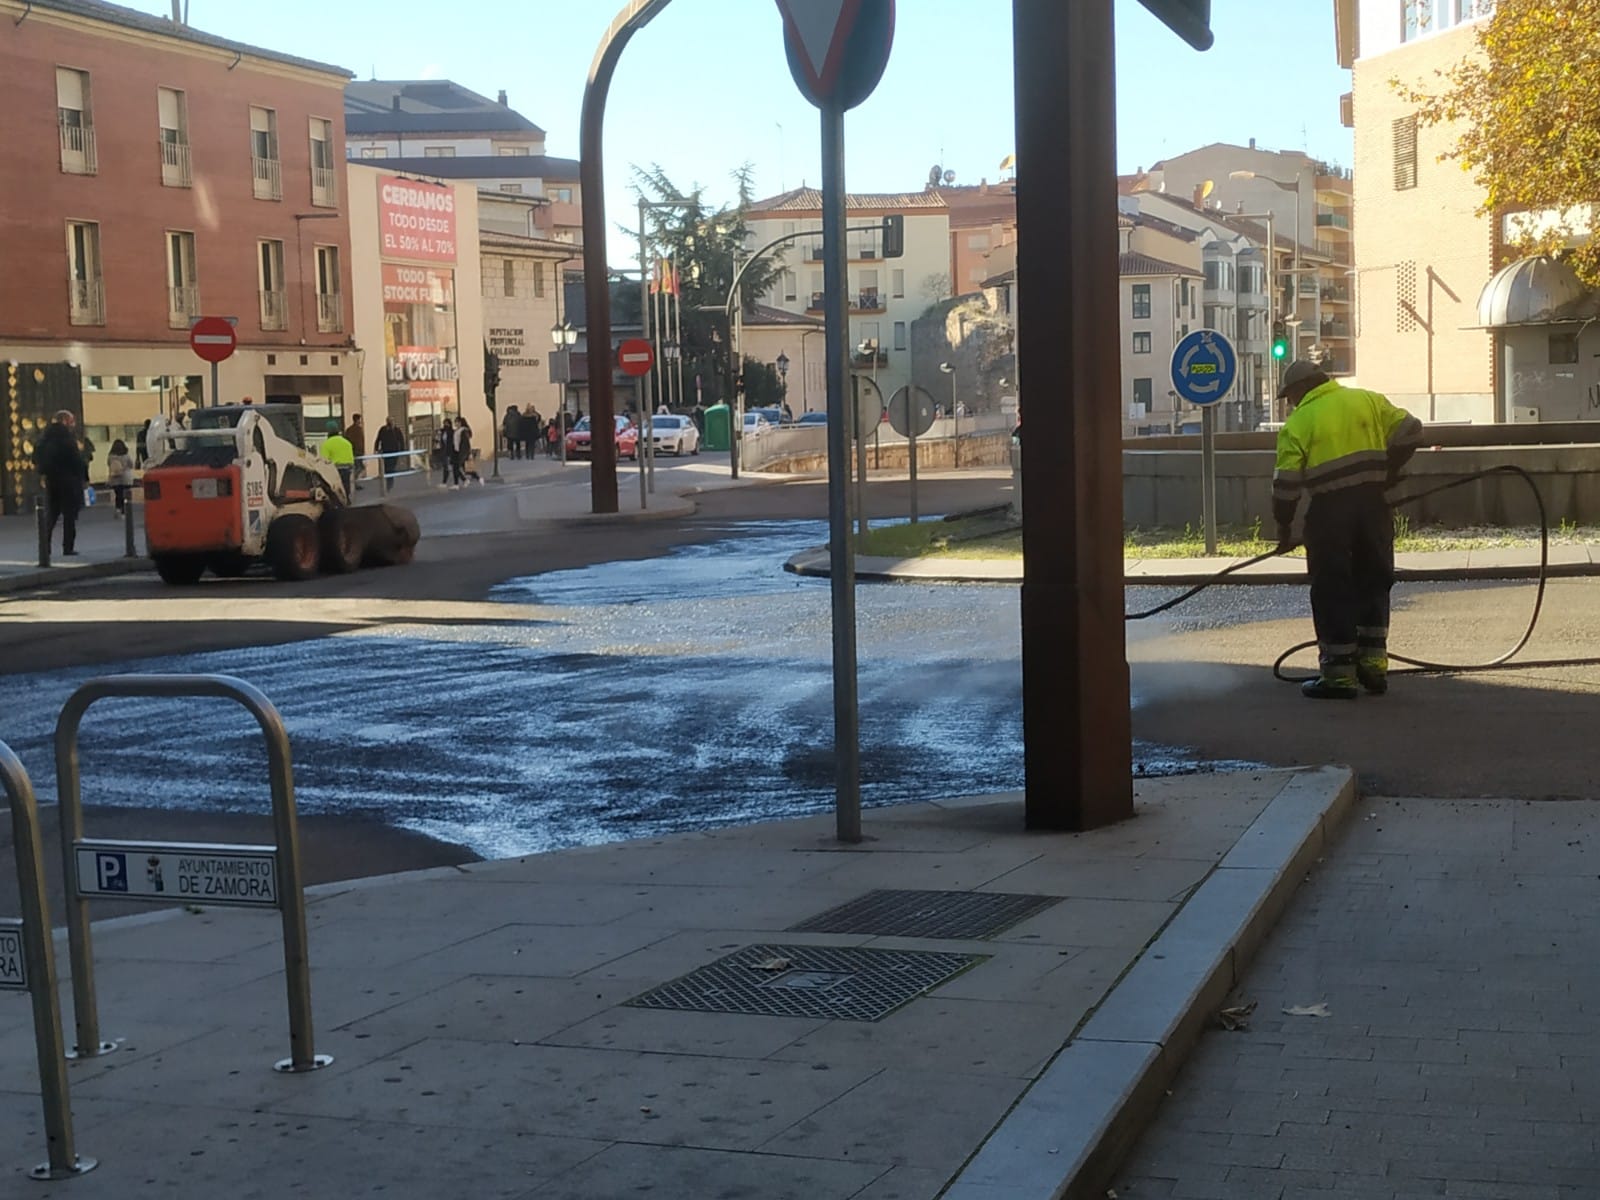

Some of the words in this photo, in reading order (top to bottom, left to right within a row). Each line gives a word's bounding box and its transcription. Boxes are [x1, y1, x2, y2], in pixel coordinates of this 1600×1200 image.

[382, 184, 453, 213] CERRAMOS
[388, 212, 417, 229] TODO
[418, 216, 449, 233] DESDE
[384, 233, 398, 248] EL
[399, 235, 419, 251] 50%
[421, 237, 435, 253] AL
[435, 239, 455, 254] 70%
[396, 268, 425, 284] TODO
[383, 285, 418, 302] STOCK
[490, 337, 525, 346] PROVINCIAL
[490, 347, 520, 355] COLEGIO
[388, 357, 404, 381] la
[408, 359, 459, 381] Cortina
[247, 481, 263, 496] S185
[99, 855, 121, 888] P
[178, 858, 271, 878] AYUNTAMIENTO
[179, 876, 201, 894] DE
[204, 877, 272, 898] ZAMORA
